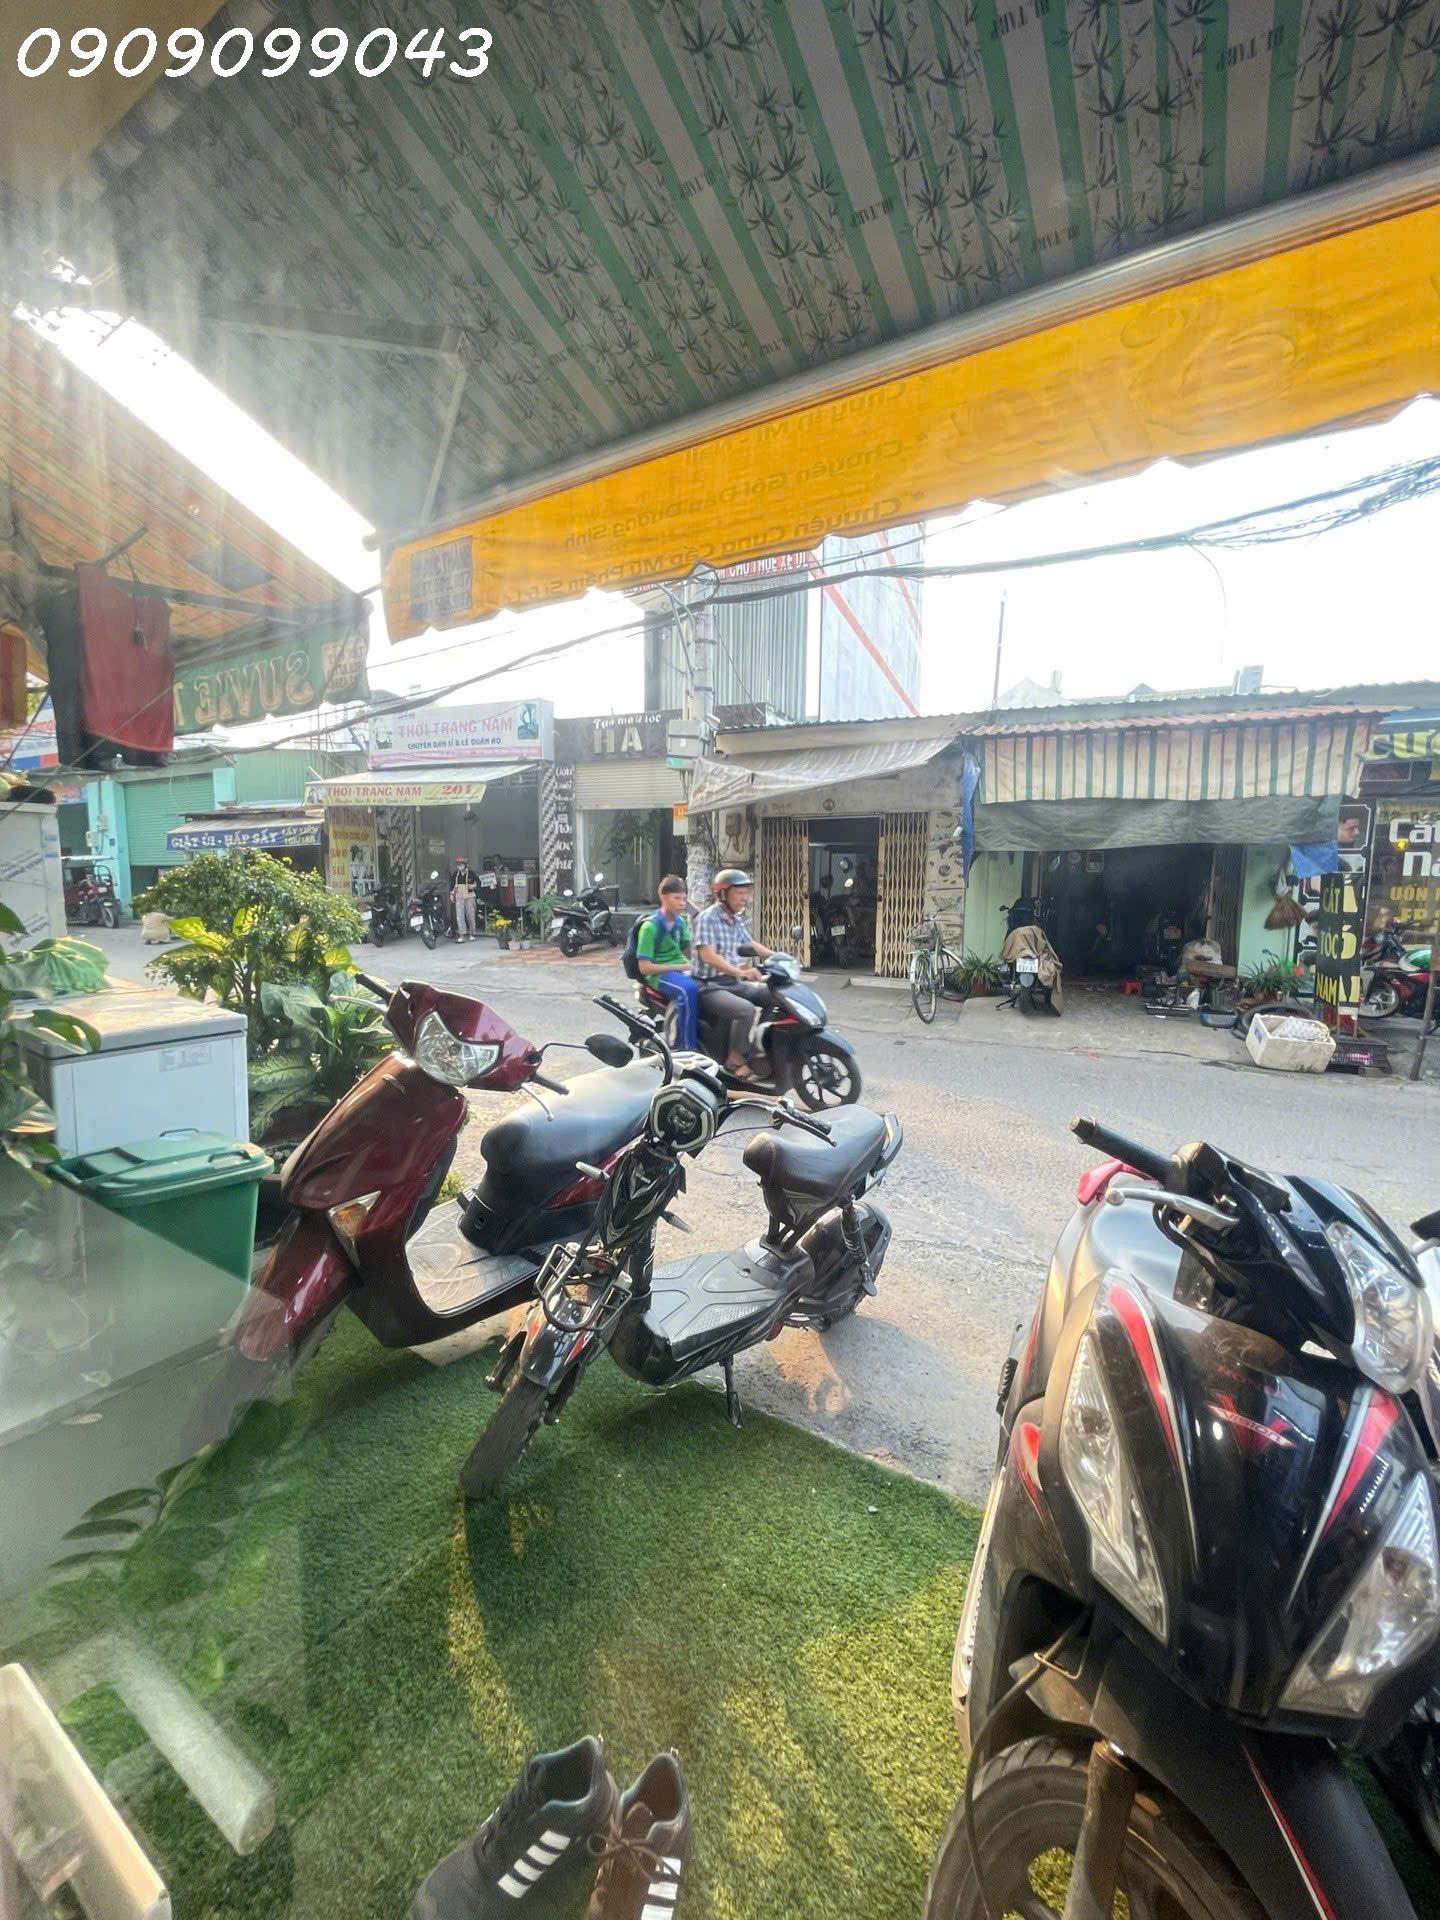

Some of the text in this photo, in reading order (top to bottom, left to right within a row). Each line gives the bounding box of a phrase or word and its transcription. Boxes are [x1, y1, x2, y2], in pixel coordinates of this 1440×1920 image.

[432, 719, 478, 736] TRANG
[481, 715, 513, 733] NAM
[355, 786, 392, 797] TRANG
[395, 786, 422, 797] NAM
[1316, 972, 1339, 1006] NAM
